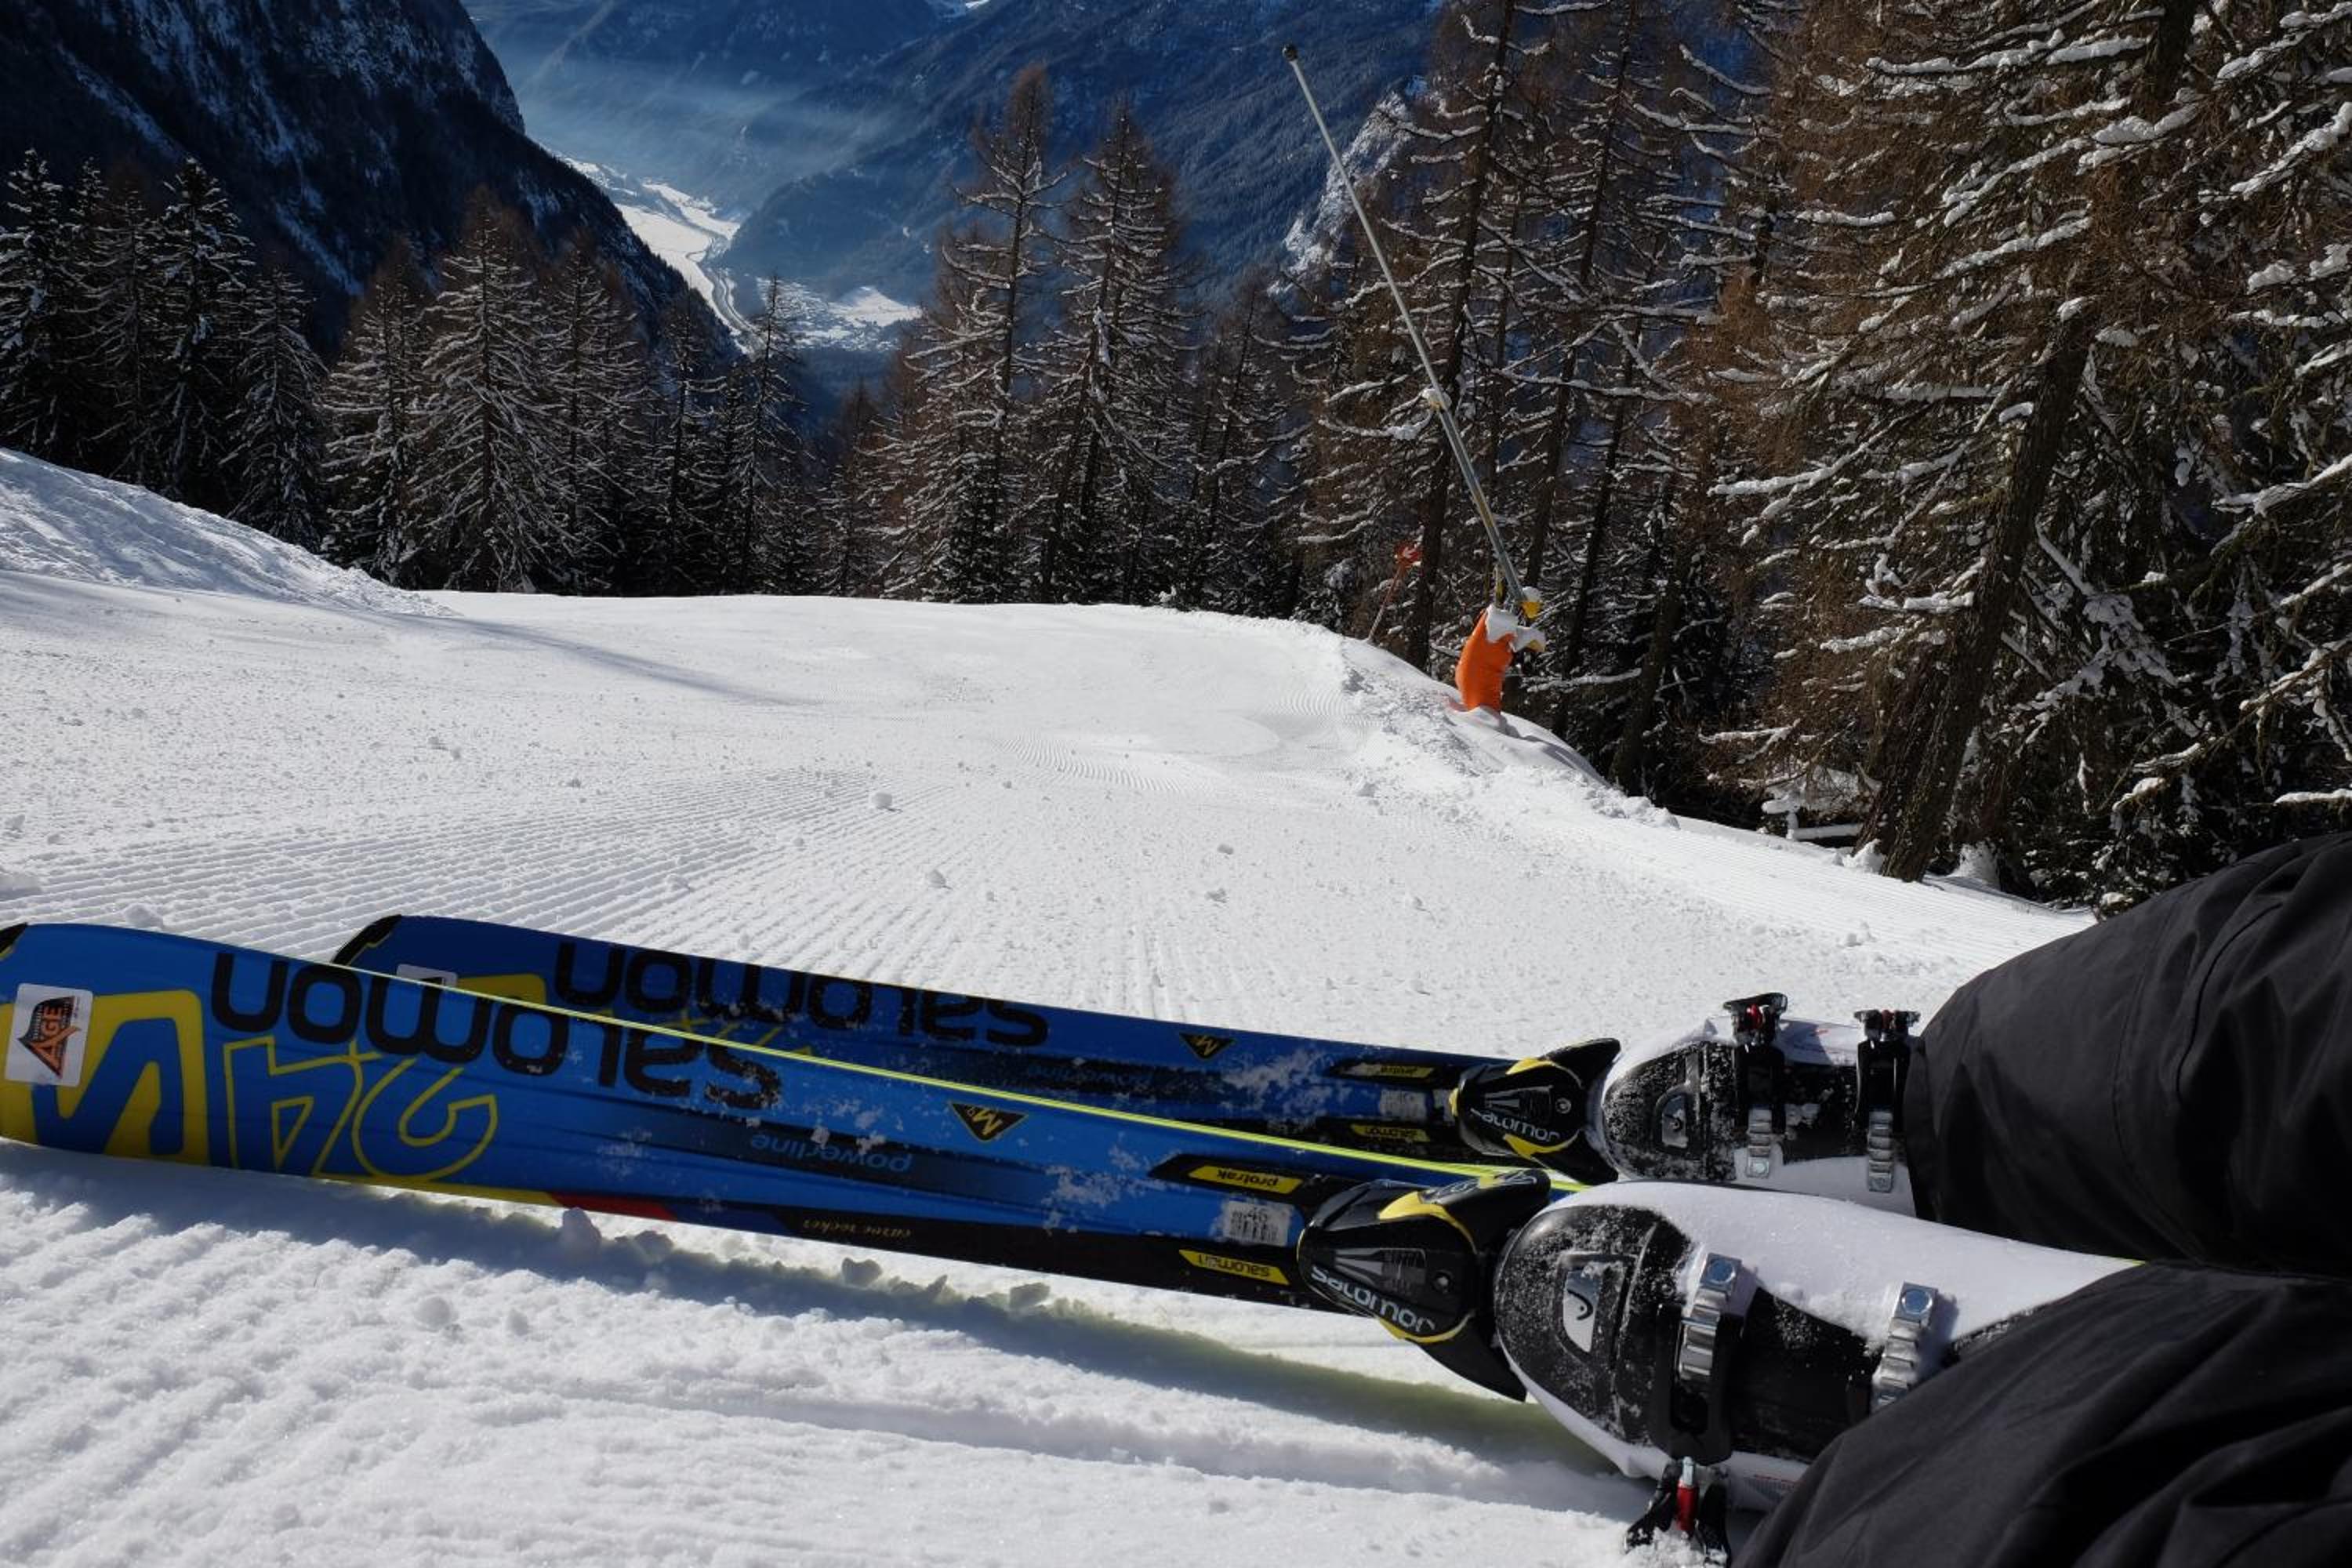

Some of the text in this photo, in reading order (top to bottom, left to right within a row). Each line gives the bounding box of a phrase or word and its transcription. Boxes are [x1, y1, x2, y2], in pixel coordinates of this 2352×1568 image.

[554, 942, 1049, 1047] salomon
[212, 952, 781, 1109] salomon
[750, 1132, 913, 1173] powerline
[1216, 1169, 1279, 1188] protrak
[1311, 1264, 1436, 1332] salomon
